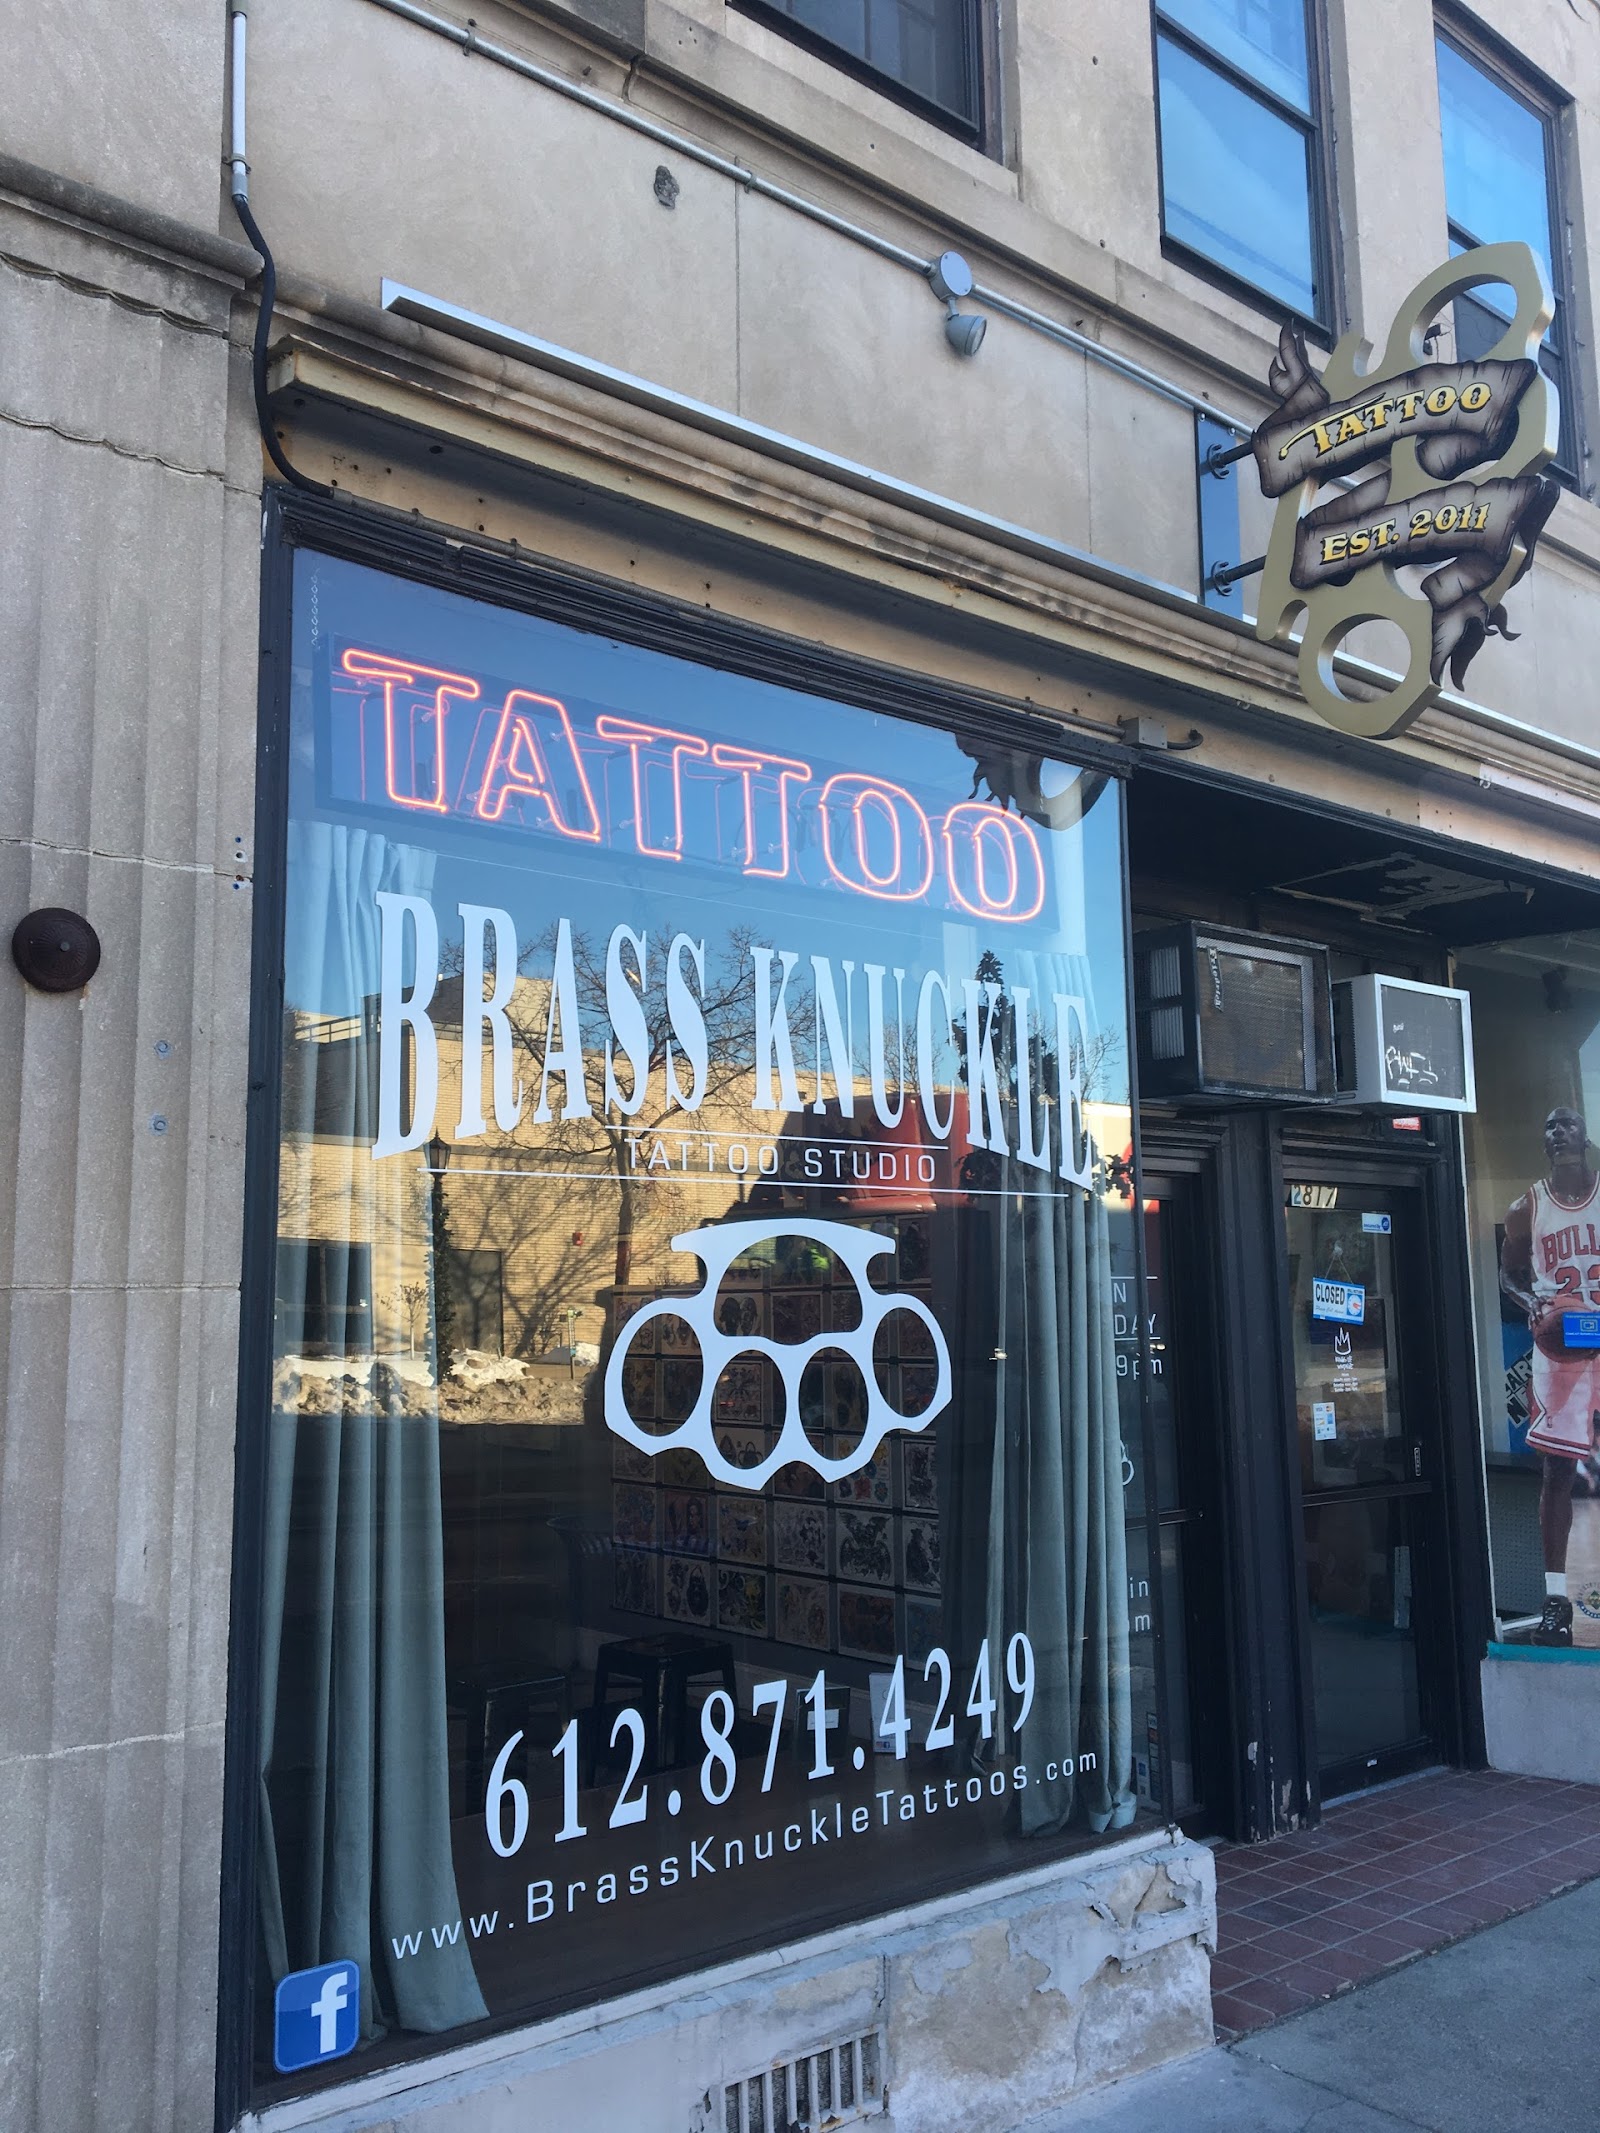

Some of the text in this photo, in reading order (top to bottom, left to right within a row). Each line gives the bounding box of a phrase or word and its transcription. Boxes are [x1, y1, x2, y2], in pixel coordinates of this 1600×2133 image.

[1279, 382, 1492, 460] TATTOO
[1319, 501, 1491, 564] EST. 2011
[342, 647, 1046, 923] TATTOO
[372, 891, 1094, 1191] BRASS KNUCKLE
[623, 1137, 936, 1183] TATTOO STUDIO
[1293, 1184, 1336, 1207] 2817
[1315, 1283, 1345, 1305] CLOSED
[485, 1632, 1036, 1858] 612.871.4249
[392, 1748, 1099, 1960] www.BrassKnuckleTattoos.com
